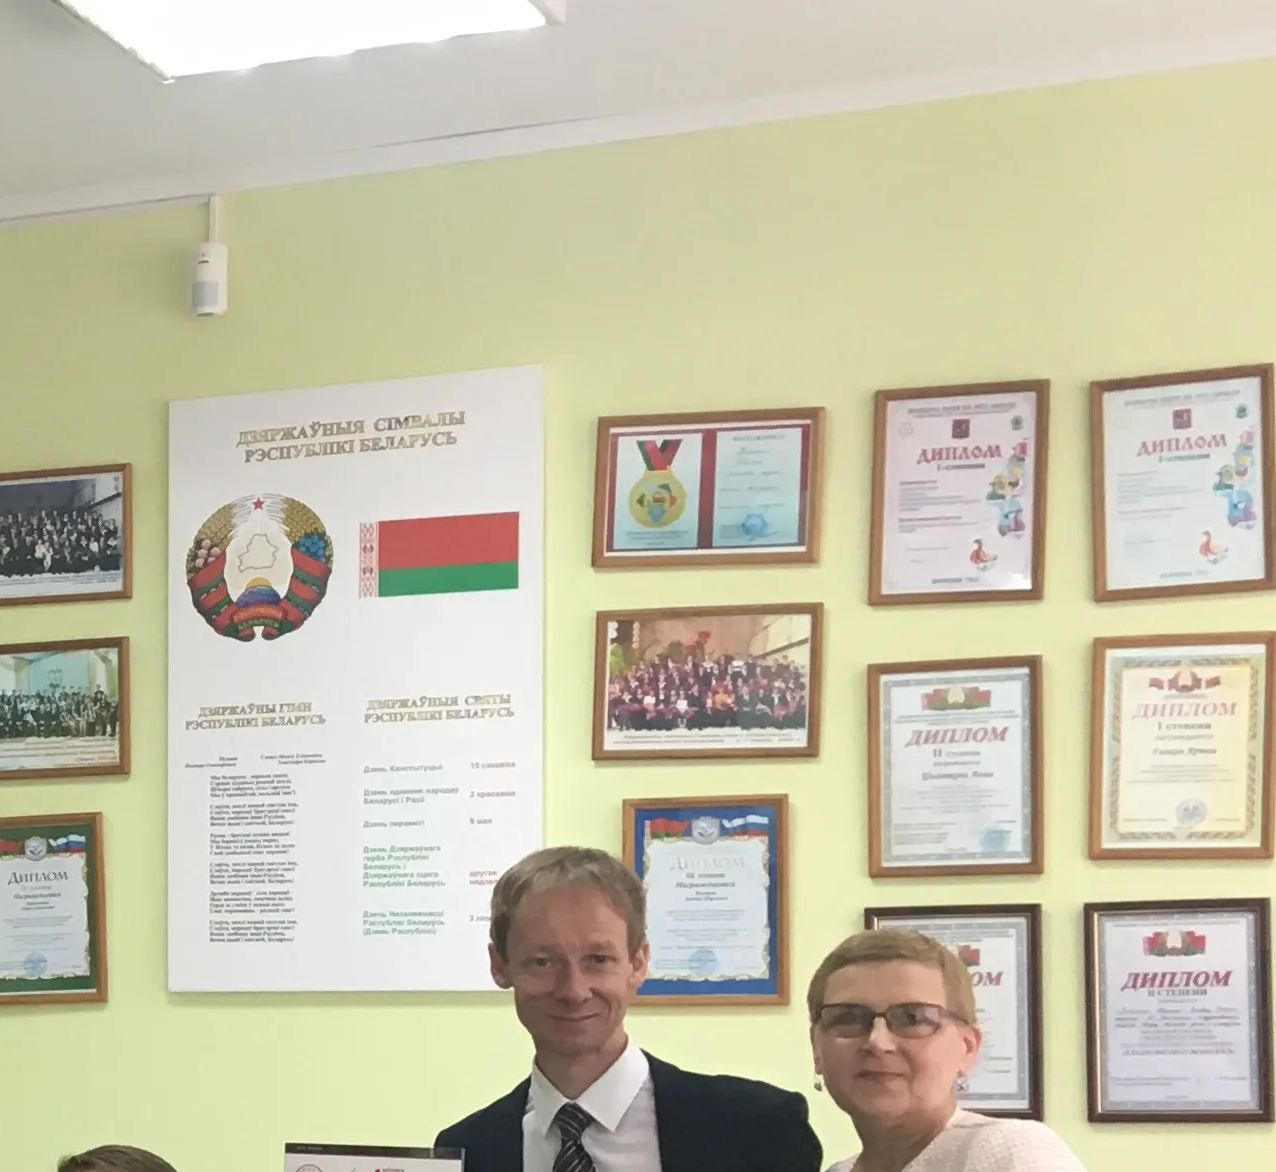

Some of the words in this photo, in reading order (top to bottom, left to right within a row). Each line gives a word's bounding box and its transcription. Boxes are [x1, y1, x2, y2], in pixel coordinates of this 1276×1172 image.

[235, 420, 365, 448] ДЗЯРЖАЎНЫЯ
[373, 411, 466, 431] СІМВАЛЫ
[244, 440, 355, 463] РЭСПУБЛІКІ
[359, 432, 458, 453] БЕЛАРУСЬ
[916, 444, 1002, 464] ДИПЛОМ
[1137, 433, 1227, 457] ДИПЛОМ
[198, 702, 276, 718] ДЗЯРЖАЎНЫ
[279, 702, 312, 713] ГІМН
[366, 696, 459, 711] ДЗЯРЖАЎНЫЯ
[464, 694, 511, 705] СВЯТЫ
[1131, 702, 1237, 720] ДИПЛОМ
[185, 716, 259, 730] РЭСПУБЛІКІ
[261, 714, 326, 727] БЕЛАРУСЬ
[364, 710, 442, 723] РЭСПУБЛІКІ
[446, 707, 515, 720] БЕЛАРУСЬ
[904, 726, 1010, 749] ДИПЛОМ
[7, 871, 69, 886] ДИПЛОМ
[1120, 970, 1233, 991] ДИПЛОМ
